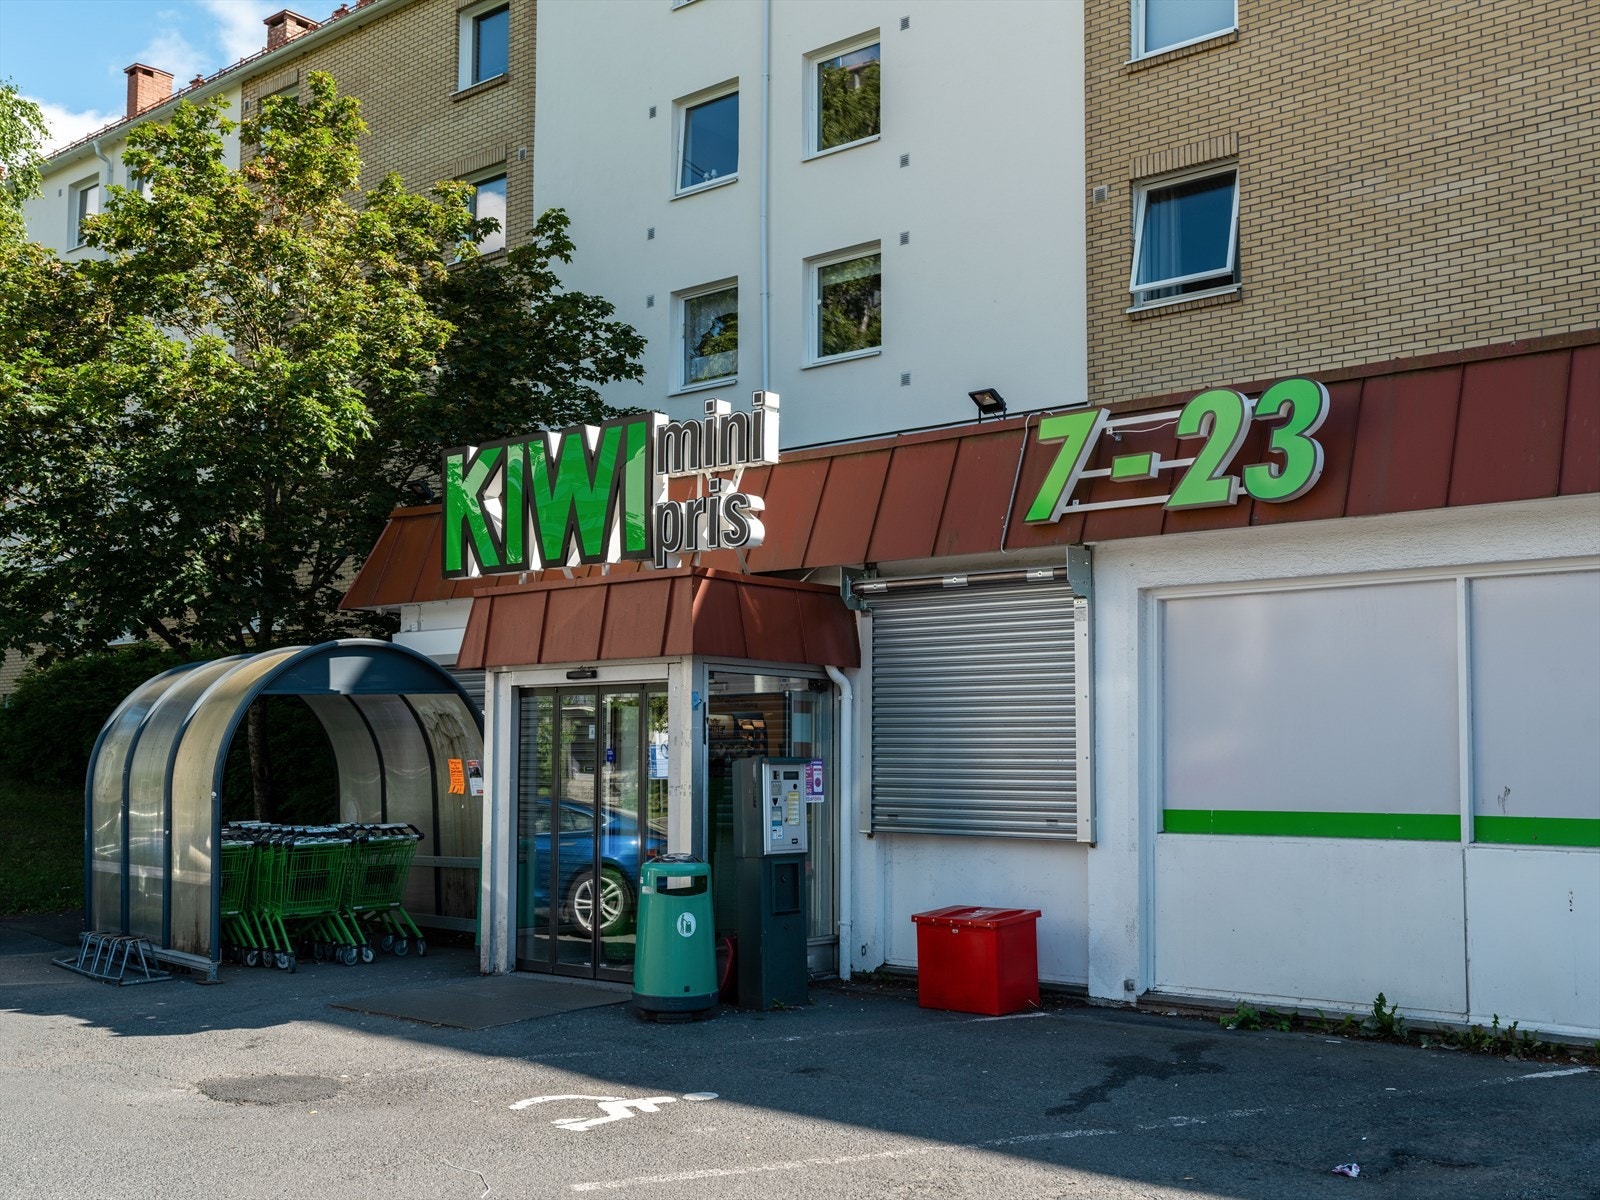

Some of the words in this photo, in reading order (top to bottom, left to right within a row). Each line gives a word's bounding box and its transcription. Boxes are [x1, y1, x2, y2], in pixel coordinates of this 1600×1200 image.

[656, 390, 766, 475] mini
[1024, 377, 1325, 523] 7-23
[443, 411, 654, 579] KIWI
[654, 478, 752, 569] pris
